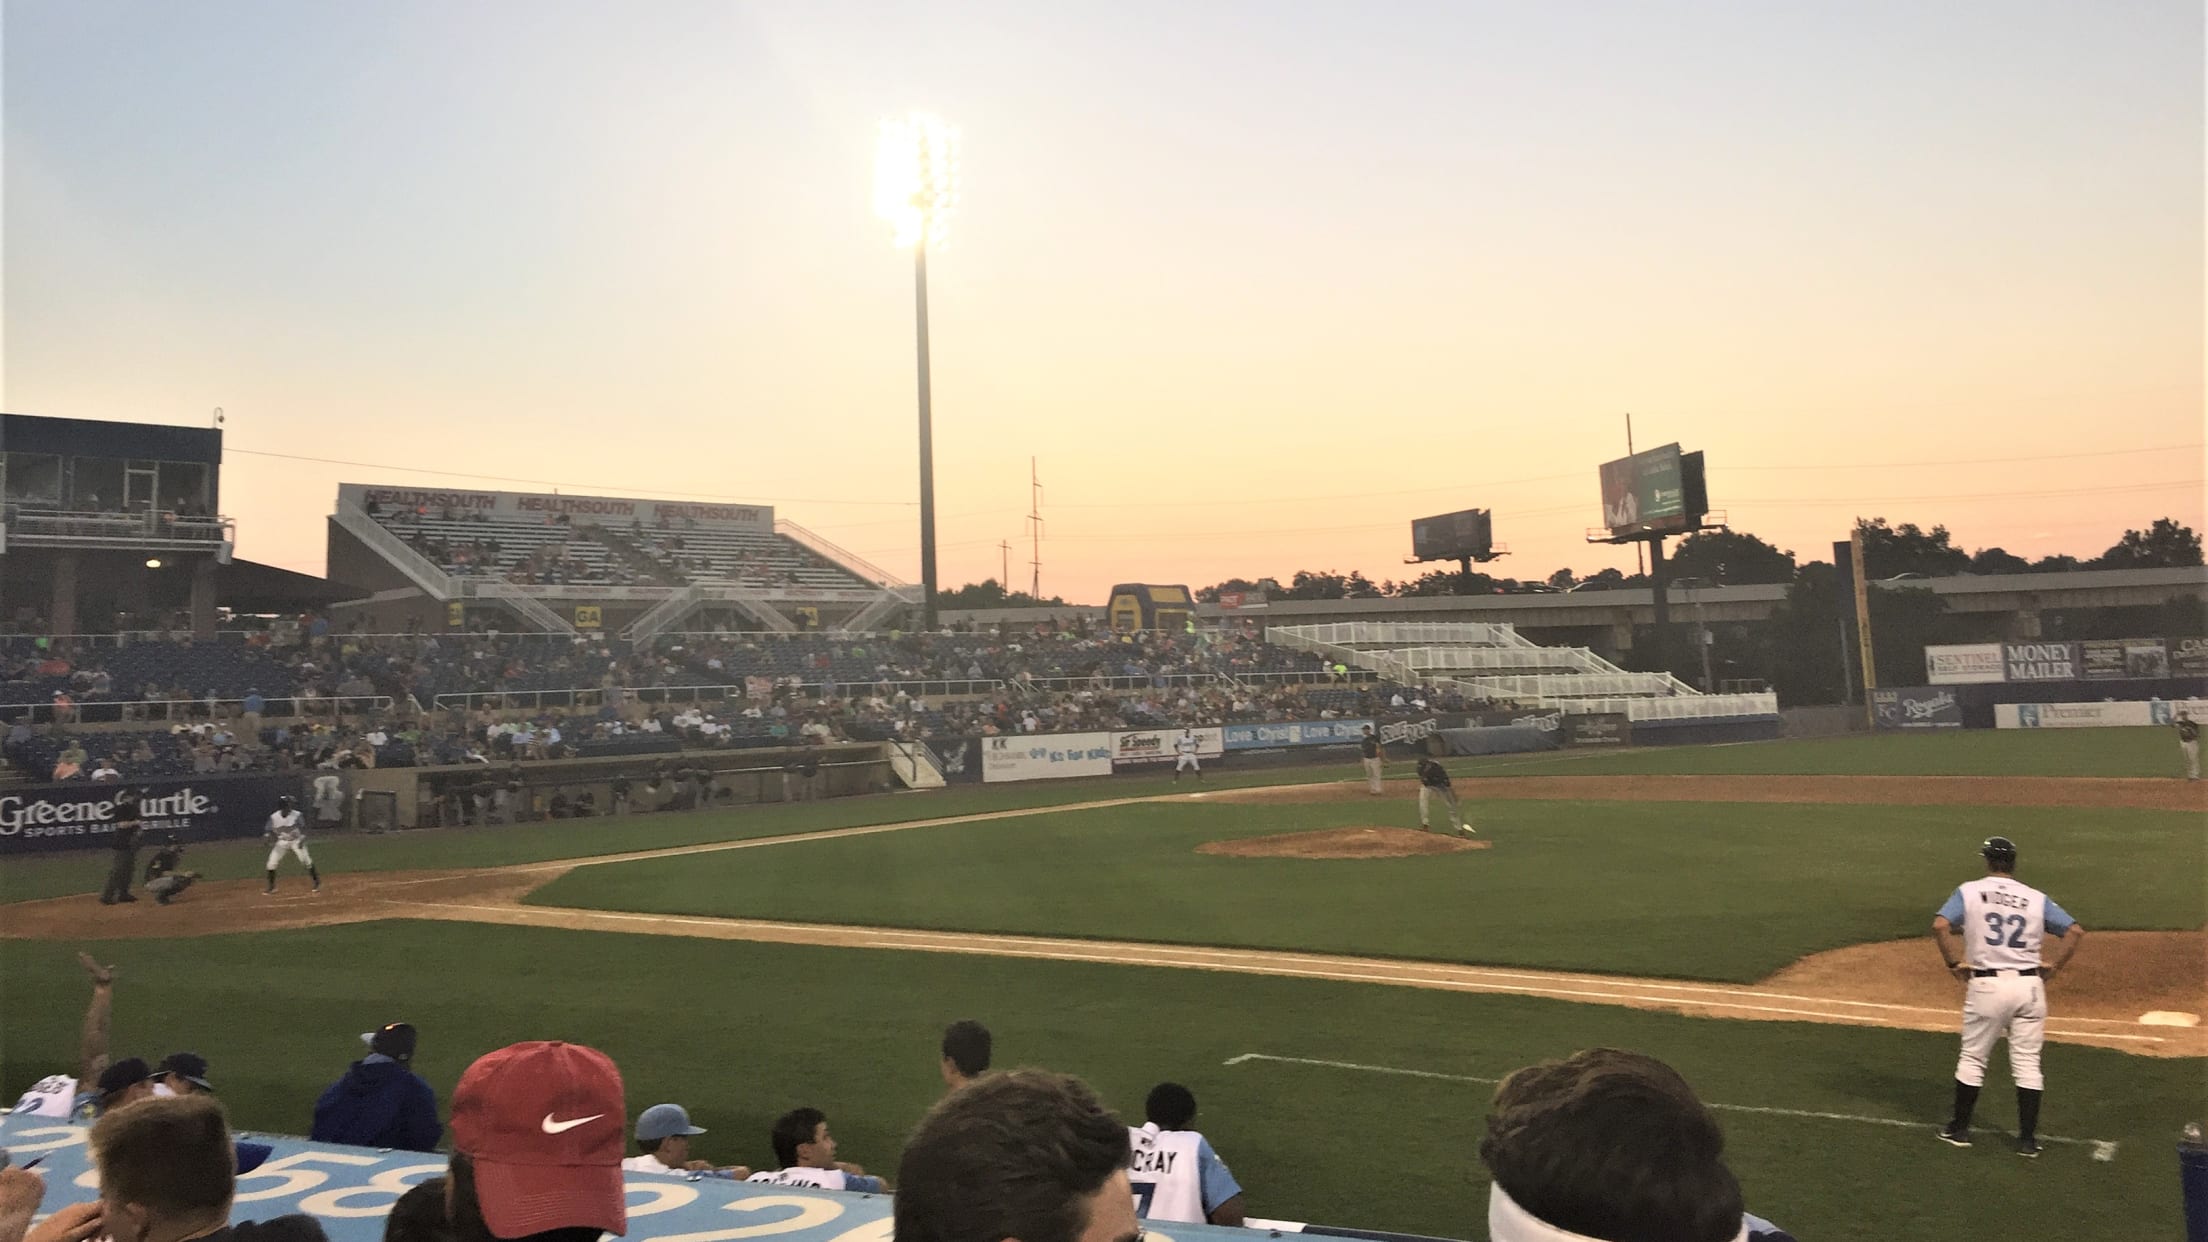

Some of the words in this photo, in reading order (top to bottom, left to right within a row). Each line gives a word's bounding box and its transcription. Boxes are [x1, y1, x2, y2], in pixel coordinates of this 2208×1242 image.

[366, 489, 497, 509] HEALTHSOUTH
[517, 497, 635, 516] HEALTHSOUTH
[654, 503, 759, 521] HEALTHSOUTH
[577, 610, 600, 623] GA
[1936, 652, 2000, 666] SENTINEL
[2006, 644, 2072, 662] MONEY
[2009, 662, 2075, 680] MAILER
[0, 796, 115, 836] Greene
[24, 825, 84, 838] SPORTS
[1979, 891, 2030, 910] WIDGER
[1984, 912, 2027, 948] 32
